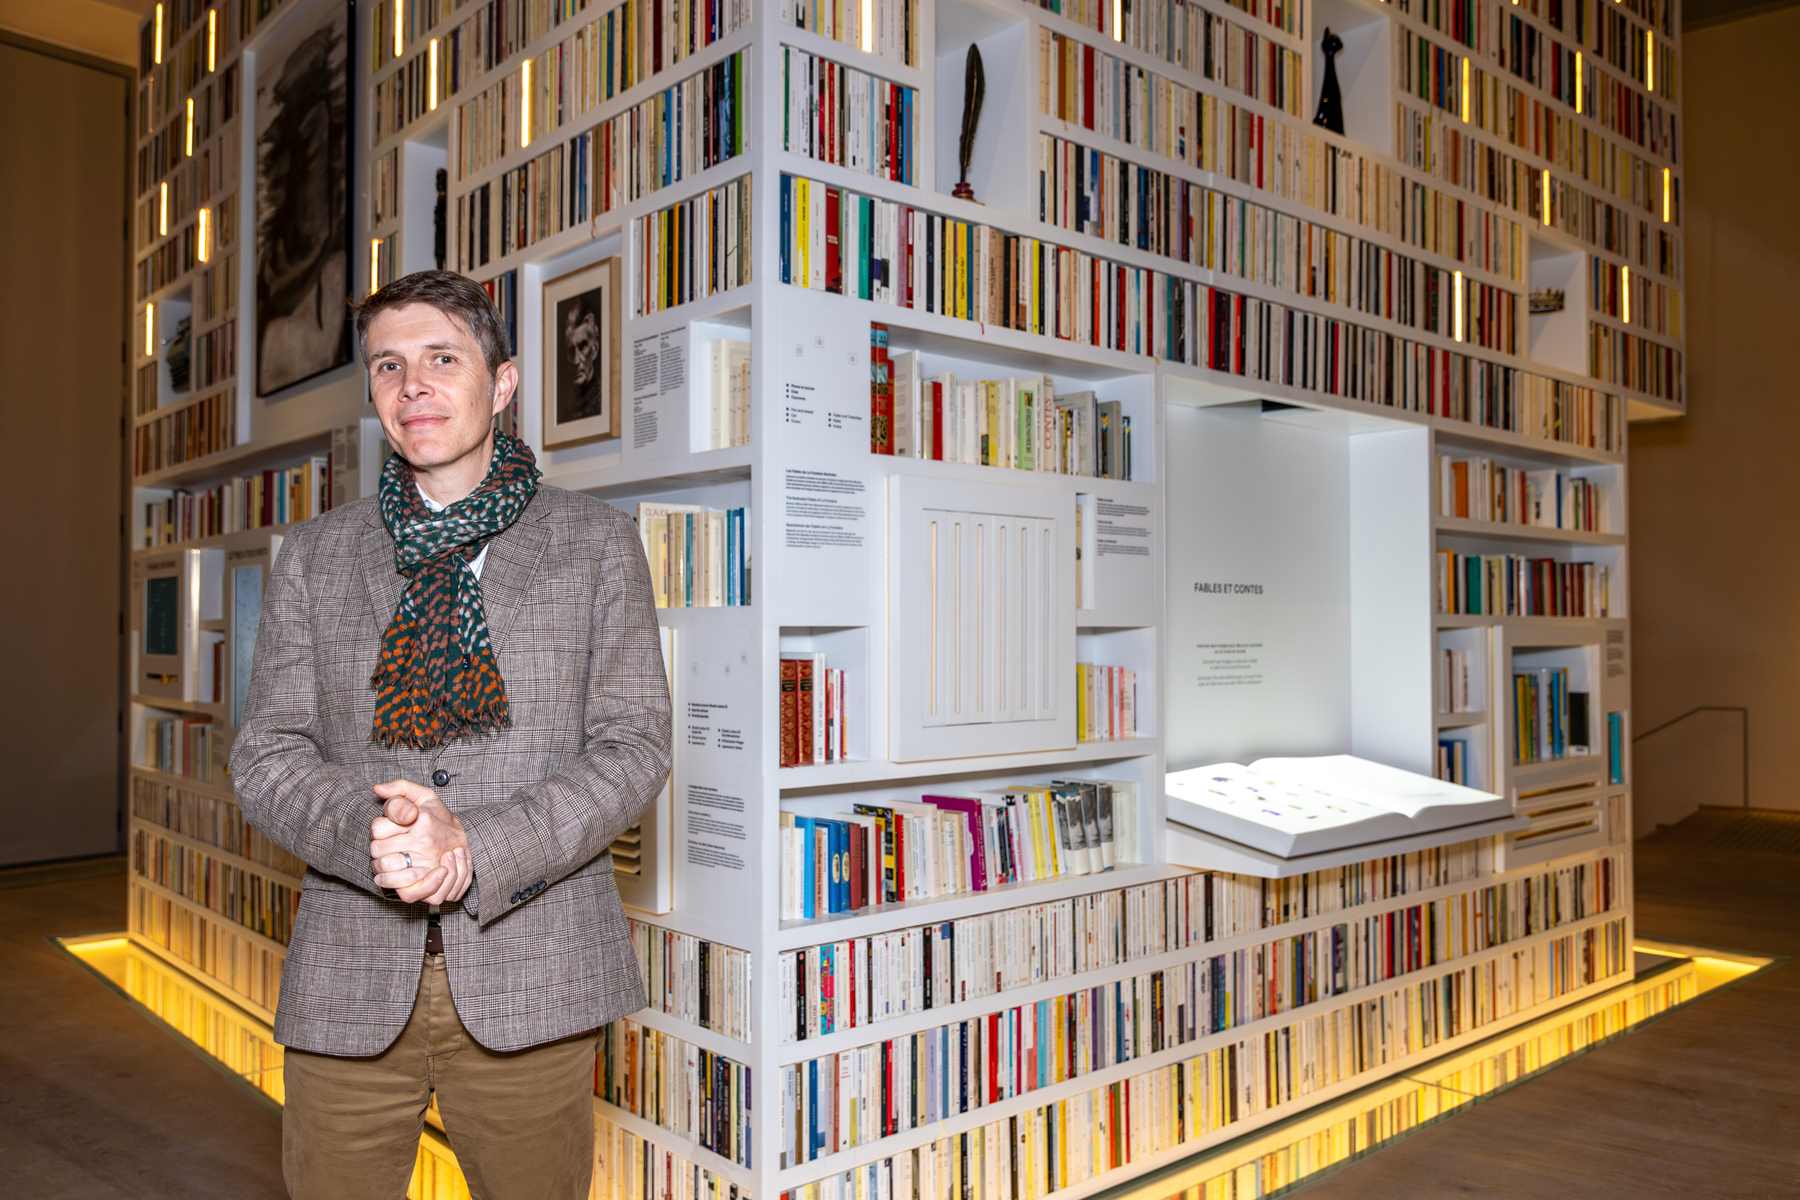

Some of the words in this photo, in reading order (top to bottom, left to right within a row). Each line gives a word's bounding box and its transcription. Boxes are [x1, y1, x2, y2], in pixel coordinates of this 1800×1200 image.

[1194, 582, 1222, 594] FABLES
[1224, 583, 1233, 594] ET
[1234, 583, 1264, 595] CONTES
